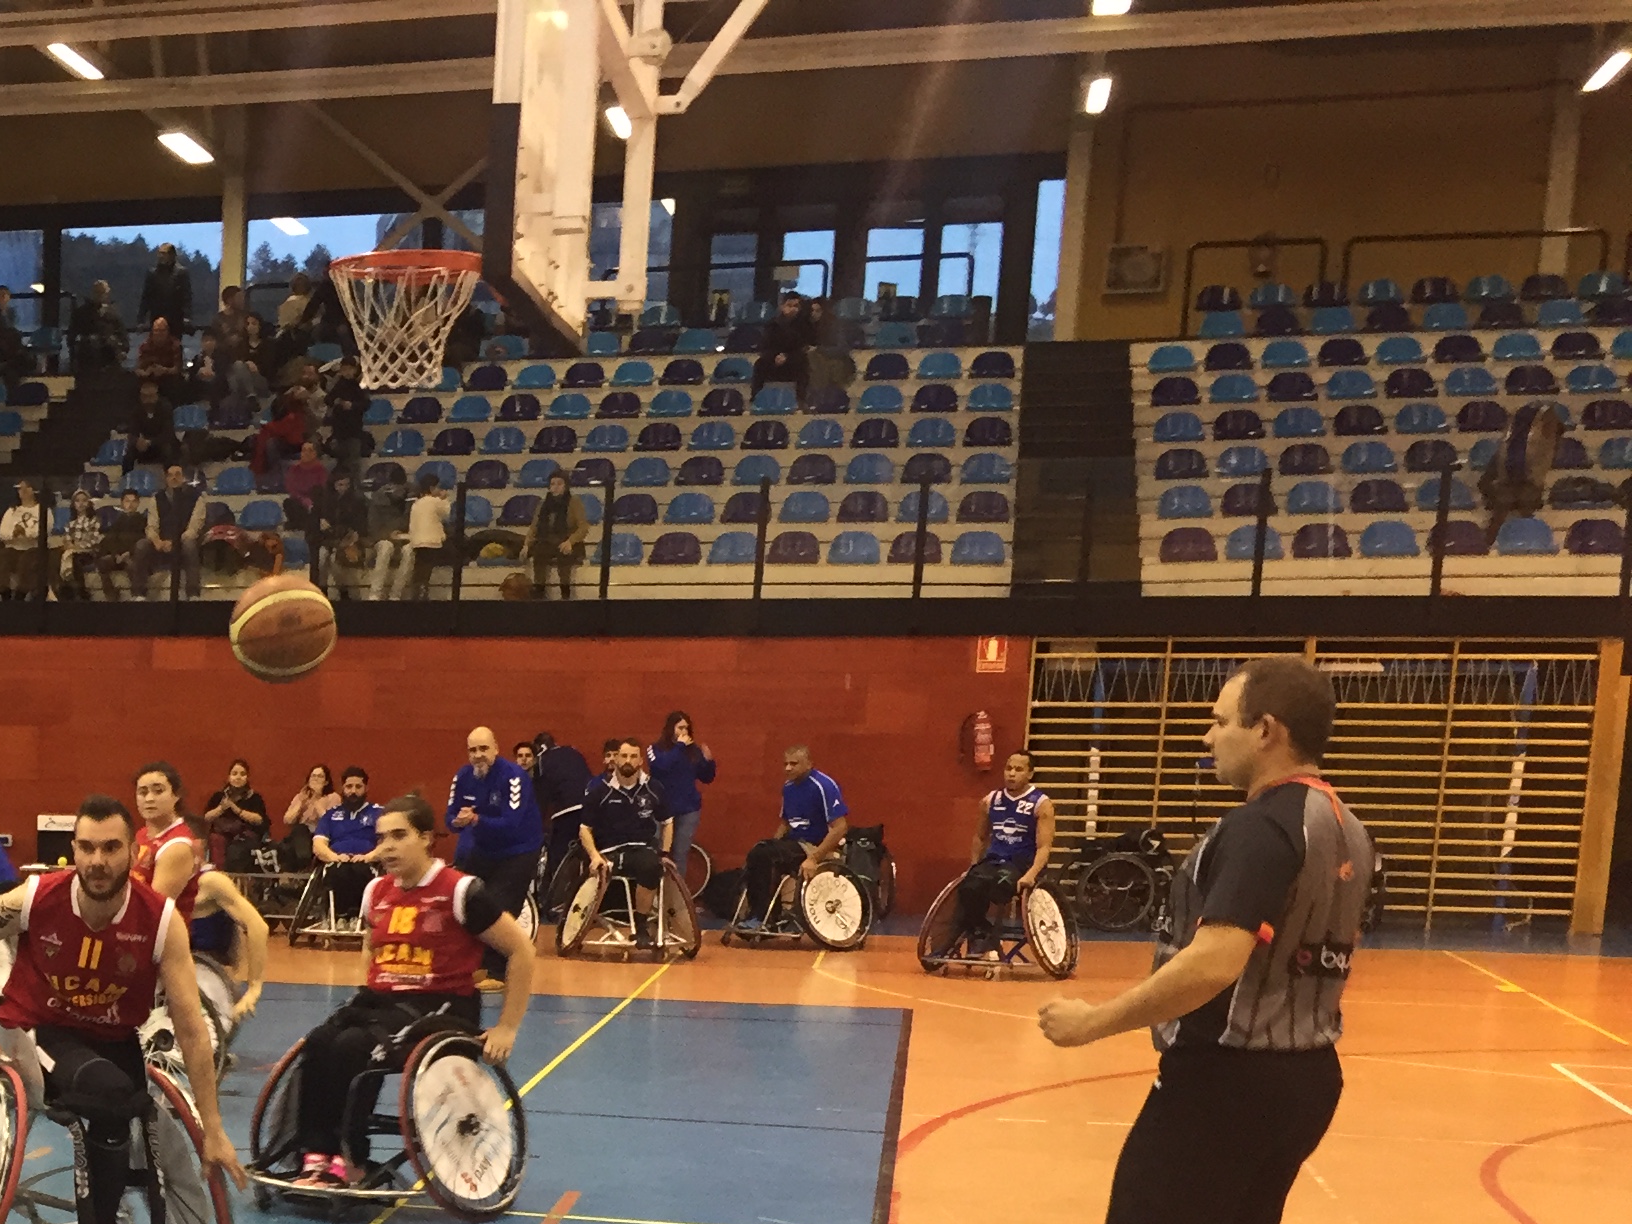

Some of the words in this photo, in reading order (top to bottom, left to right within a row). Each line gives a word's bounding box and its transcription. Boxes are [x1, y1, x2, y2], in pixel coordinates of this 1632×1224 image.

[1015, 800, 1034, 815] 22
[387, 906, 419, 935] 18
[77, 935, 103, 971] 11
